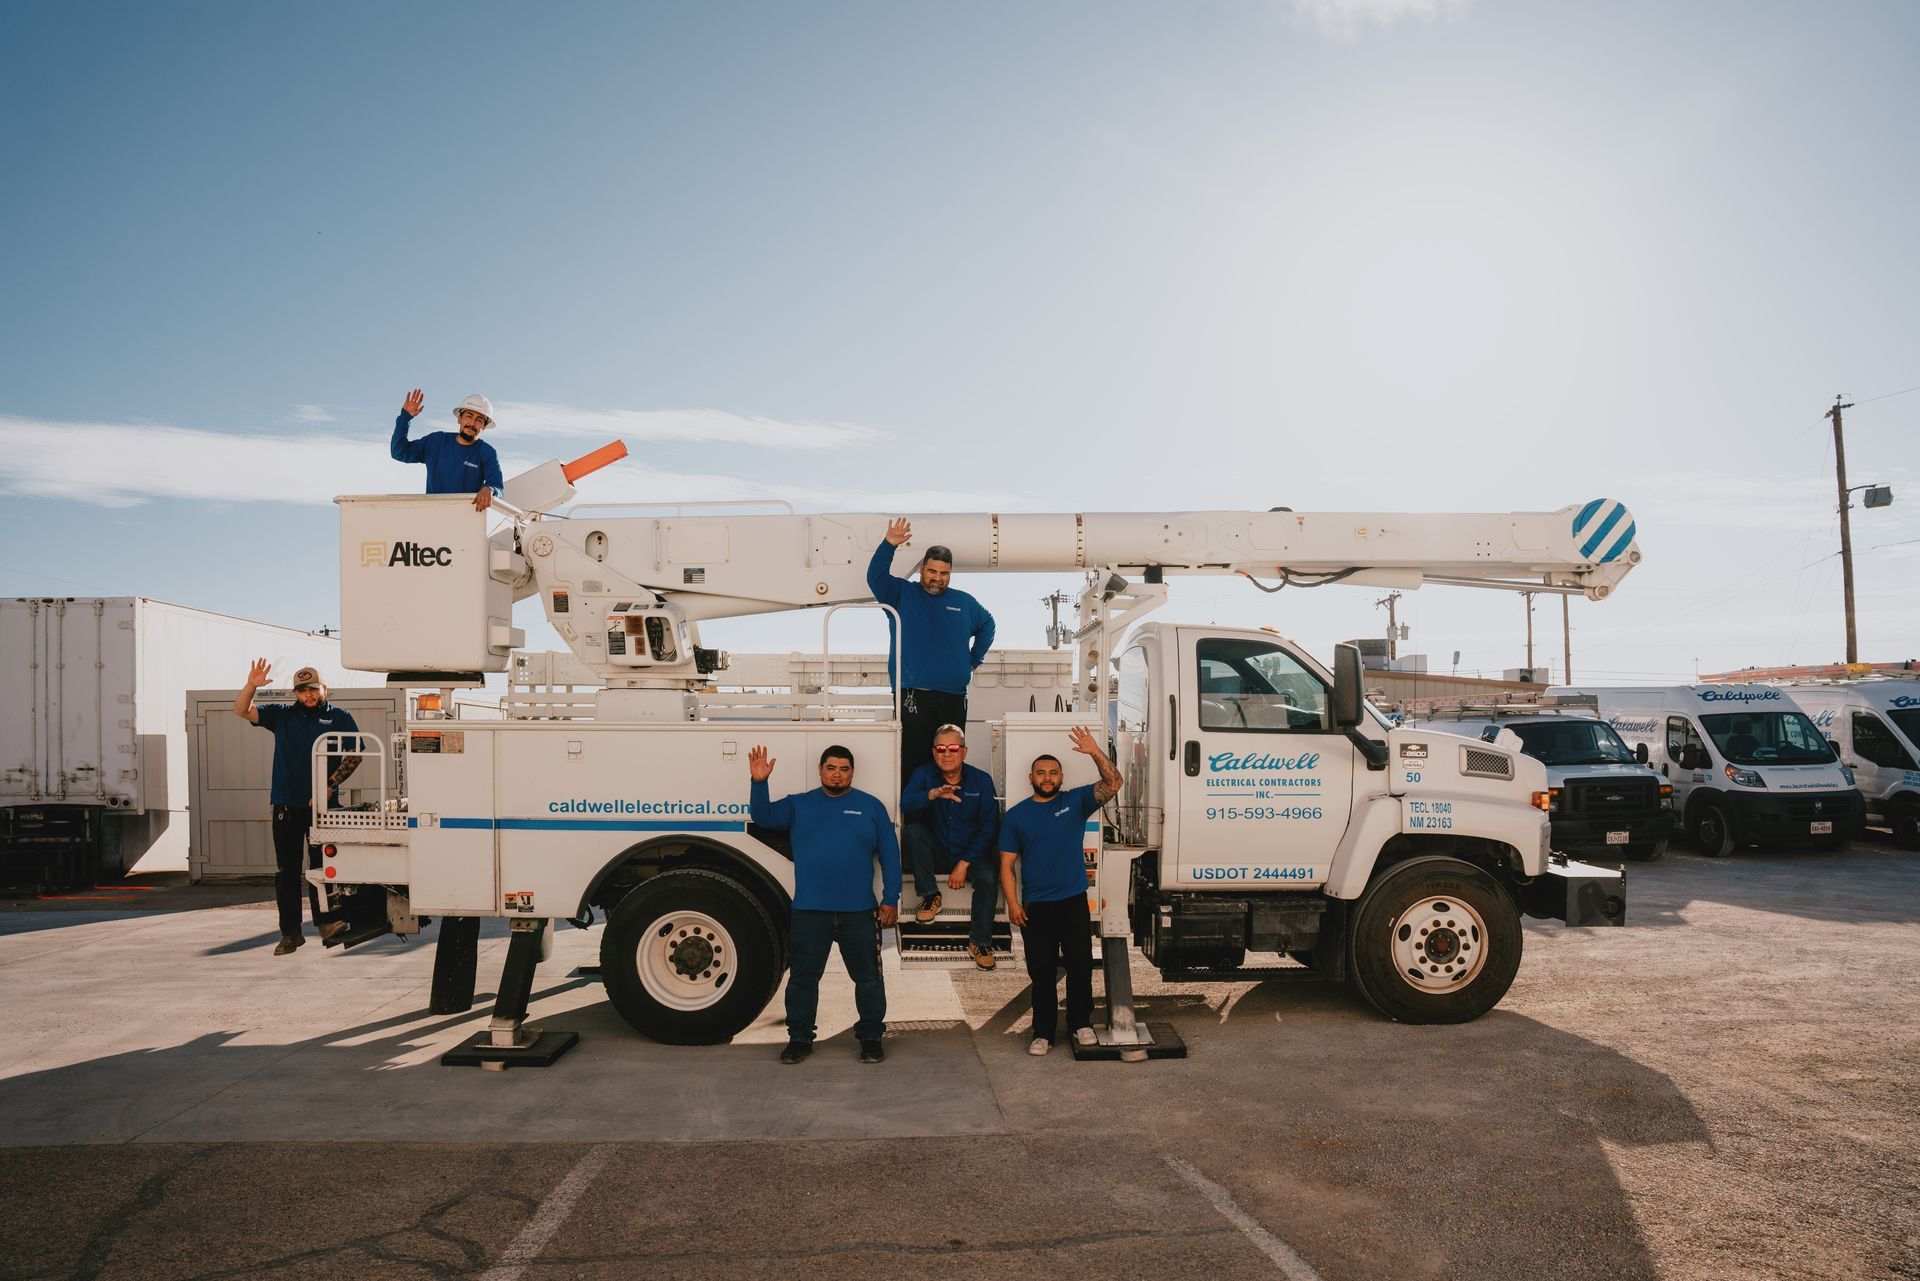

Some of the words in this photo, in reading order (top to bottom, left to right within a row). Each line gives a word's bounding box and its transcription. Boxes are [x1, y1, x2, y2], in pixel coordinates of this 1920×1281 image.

[388, 541, 452, 567] Altec
[1697, 690, 1781, 702] Caldwell
[1208, 752, 1320, 772] Caldwell
[1206, 778, 1256, 787] ELECTRICAL
[1259, 778, 1321, 787] CONTRACTORS
[1406, 772, 1421, 782] 50
[1255, 790, 1274, 799] INC.
[1206, 807, 1323, 820] 915-593-4966
[1410, 802, 1429, 813] TECL
[1432, 803, 1452, 814] 18040
[1410, 817, 1424, 828] NM
[1427, 817, 1452, 828] 23163
[1192, 867, 1248, 880] USDOT
[1253, 867, 1314, 880] 2444491
